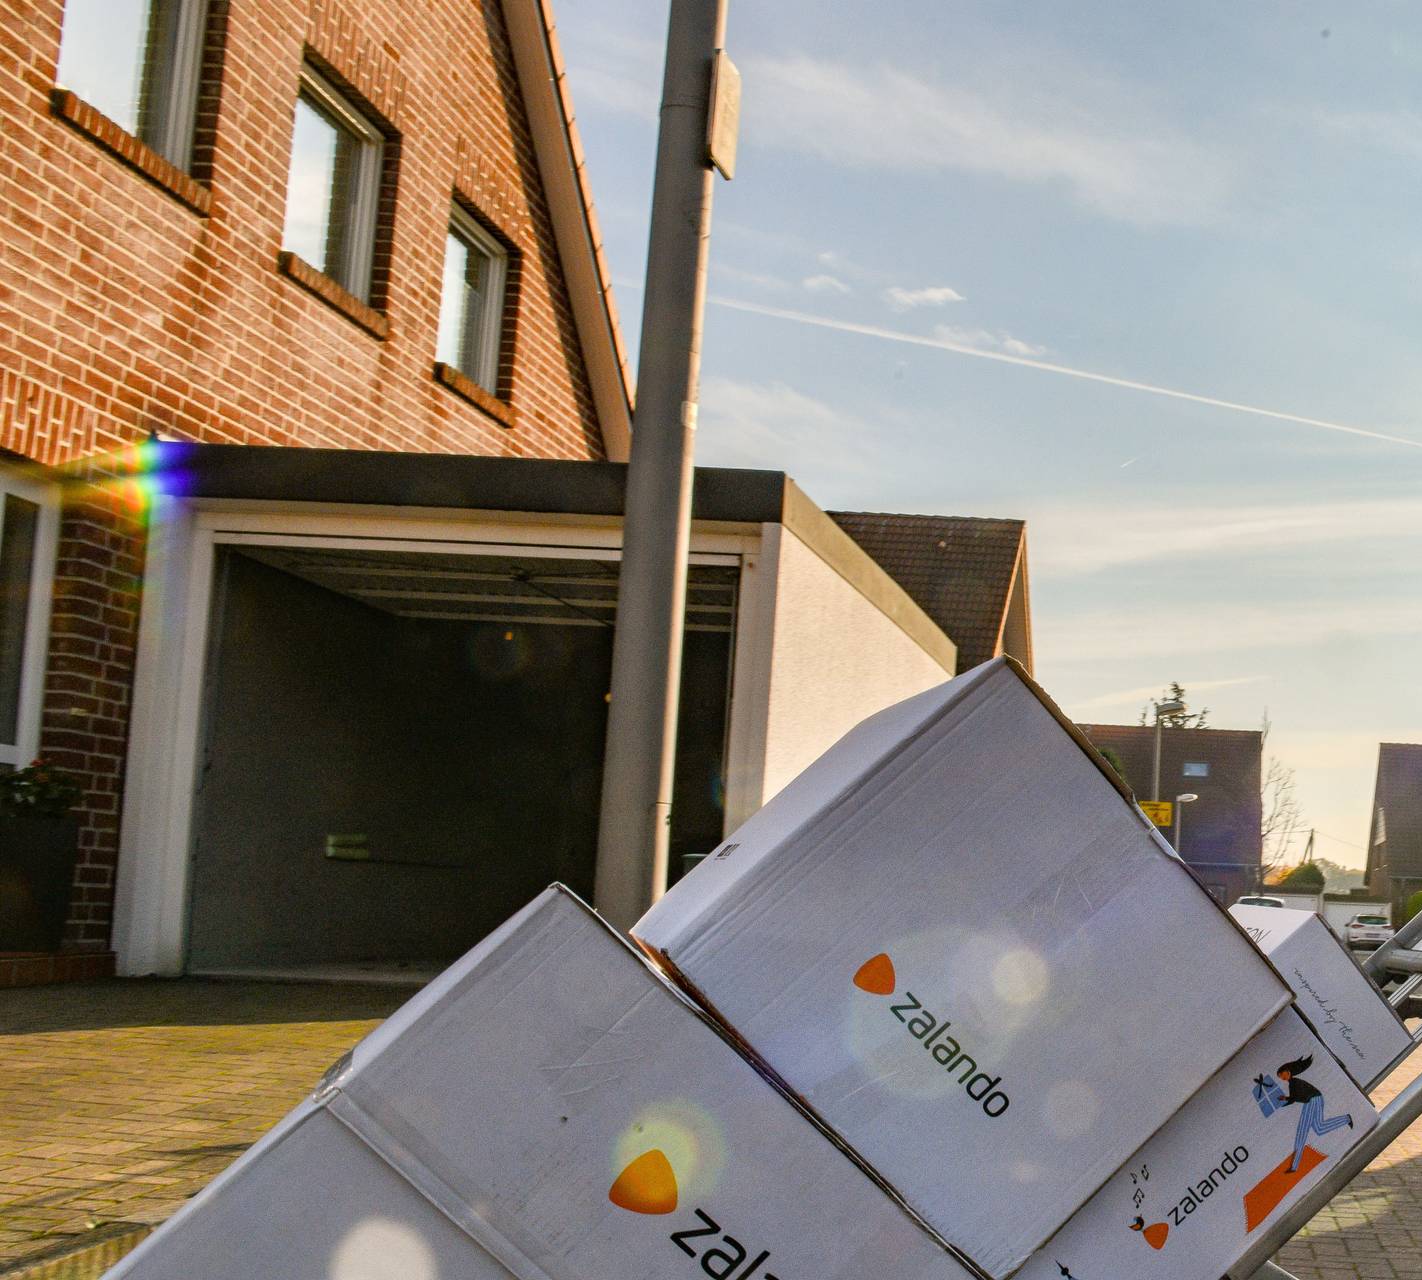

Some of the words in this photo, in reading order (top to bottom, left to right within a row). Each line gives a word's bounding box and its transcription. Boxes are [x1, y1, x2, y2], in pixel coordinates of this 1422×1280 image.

[890, 991, 1010, 1118] zalando
[1167, 1146, 1249, 1226] zalando
[669, 1208, 782, 1280] zal
